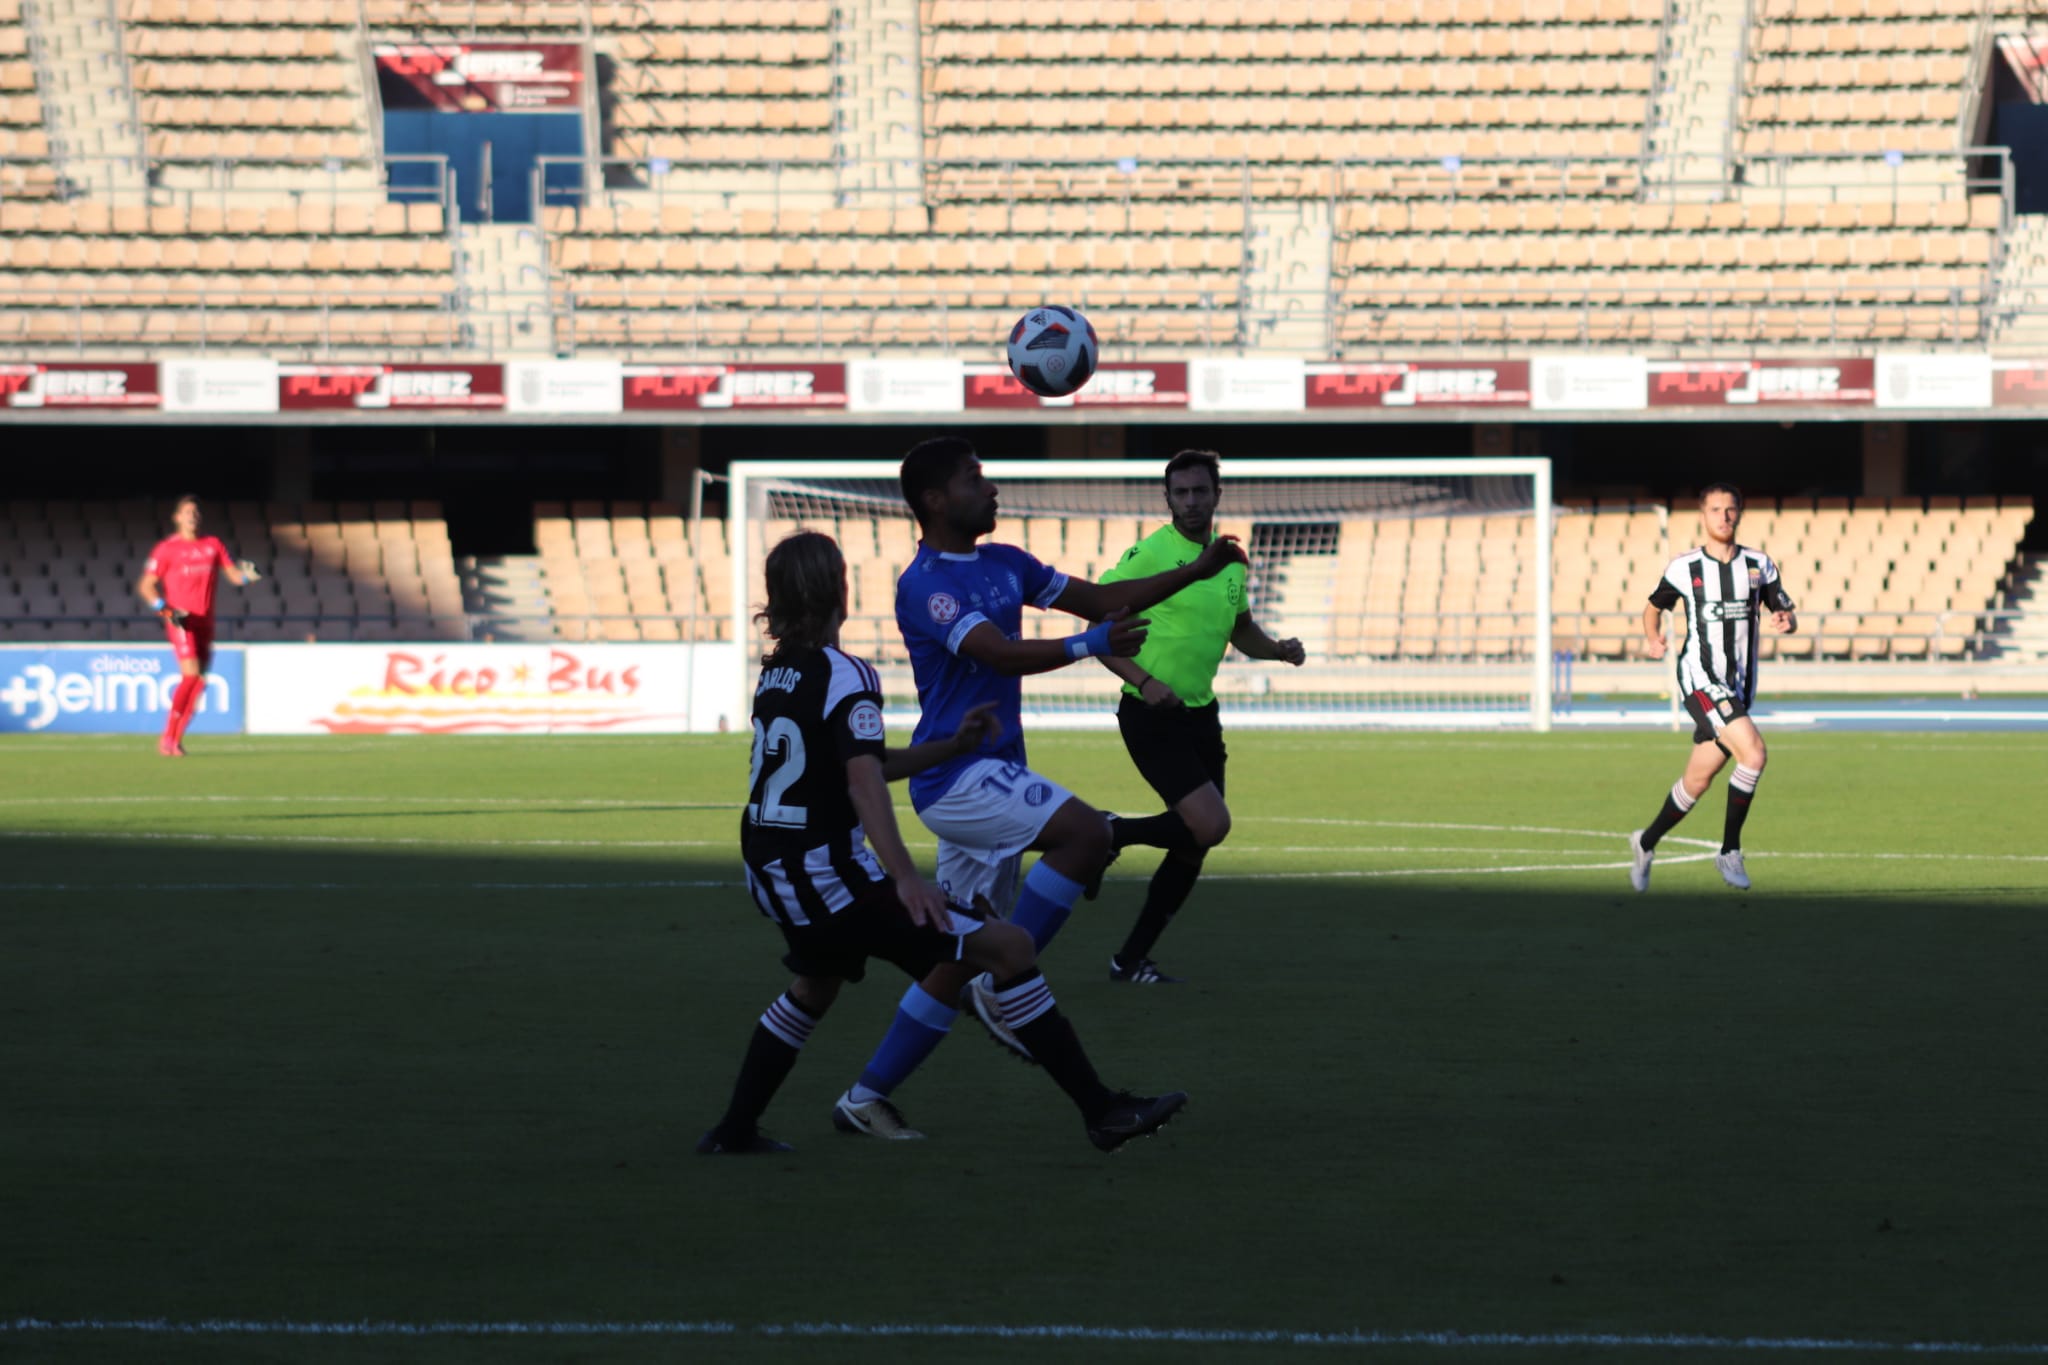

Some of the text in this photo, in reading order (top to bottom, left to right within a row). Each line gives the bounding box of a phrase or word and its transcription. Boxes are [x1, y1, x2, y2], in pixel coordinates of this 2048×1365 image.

[11, 370, 127, 406] JEREZ
[289, 374, 374, 396] PLAY
[355, 370, 473, 407] JEREZ
[633, 374, 718, 396] PLAY
[699, 370, 814, 407] JEREZ
[1315, 373, 1399, 394] PLAY
[1382, 369, 1497, 405] JEREZ
[1658, 371, 1742, 392] PLAY
[1726, 367, 1840, 403] JEREZ
[384, 650, 641, 695] Rico Bus
[757, 666, 802, 697] CARLOS
